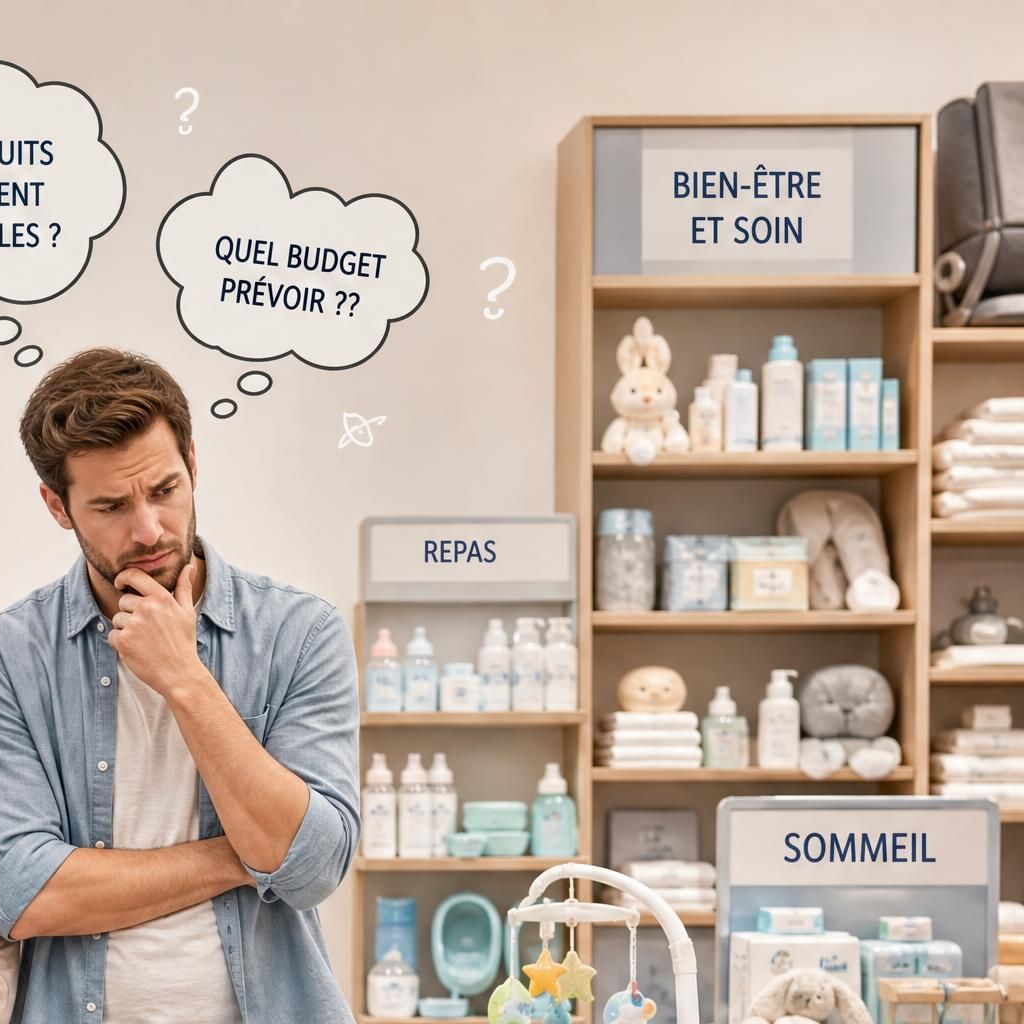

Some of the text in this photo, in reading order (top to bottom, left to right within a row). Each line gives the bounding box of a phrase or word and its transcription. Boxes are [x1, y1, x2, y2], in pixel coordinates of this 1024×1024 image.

[673, 163, 822, 199] BIEN-ÊTRE
[691, 215, 803, 245] ET SOIN
[424, 539, 497, 564] REPAS
[783, 832, 937, 864] SOMMEIL
